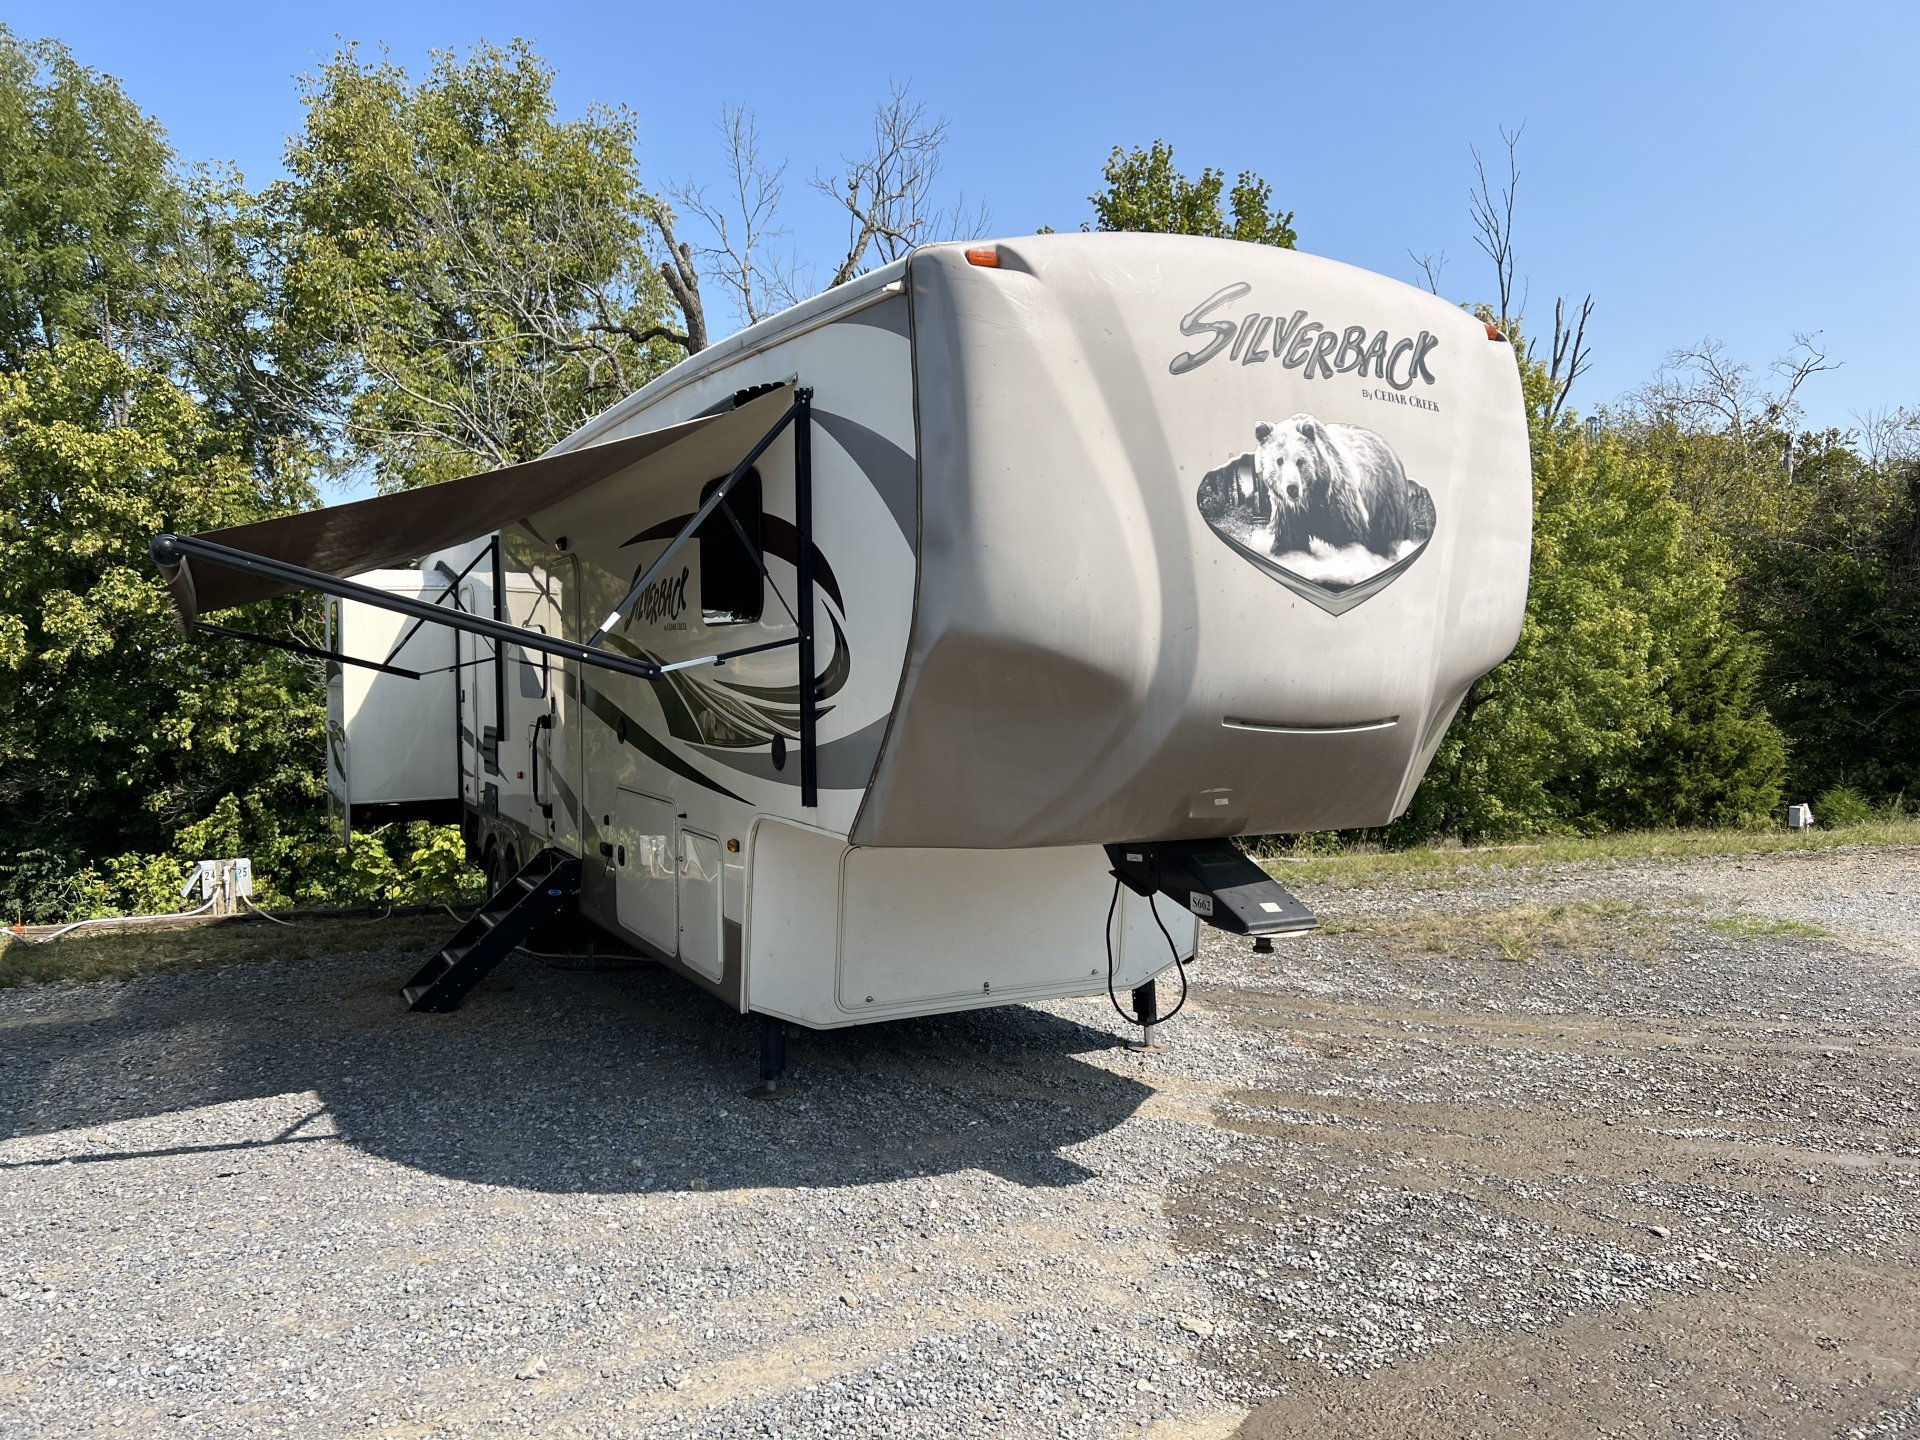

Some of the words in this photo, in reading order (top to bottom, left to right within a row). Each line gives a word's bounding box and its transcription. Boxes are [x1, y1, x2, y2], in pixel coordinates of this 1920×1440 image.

[1168, 281, 1440, 391] SILVERBACK
[1361, 388, 1373, 401] By
[1374, 388, 1407, 406] CEDAR
[1409, 394, 1441, 413] CREEK
[205, 870, 216, 880] 24
[1193, 897, 1210, 911] S662
